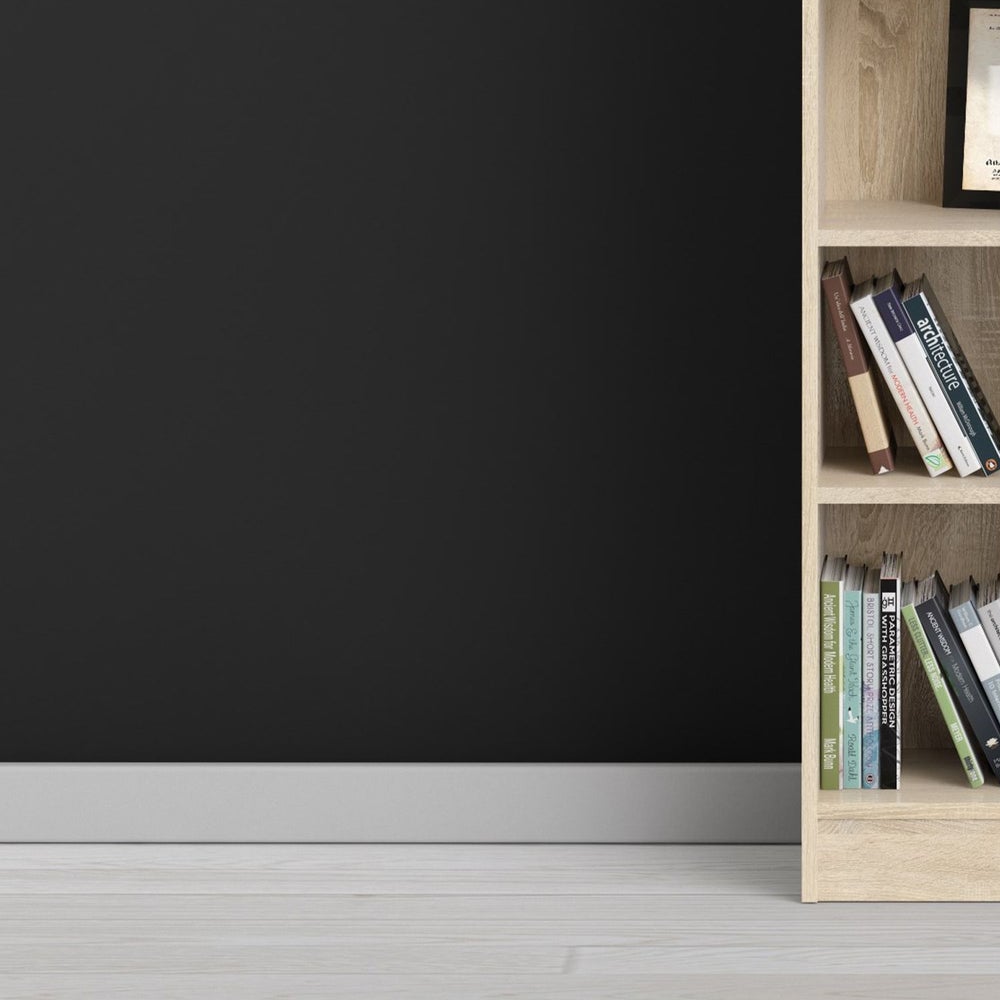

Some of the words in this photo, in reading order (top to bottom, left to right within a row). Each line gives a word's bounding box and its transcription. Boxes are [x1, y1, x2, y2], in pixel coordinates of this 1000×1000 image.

[858, 305, 876, 335] ANCIENT
[872, 335, 890, 365] WISDOM
[890, 373, 907, 402] MODERN
[904, 401, 918, 424] HEALTH
[917, 317, 960, 391] architecture
[823, 593, 836, 616] Ancient
[866, 597, 875, 631] BRISTOL
[823, 616, 836, 640] Wisdom
[925, 610, 941, 633] ANCIENT
[936, 632, 952, 655] WISDOM
[866, 632, 875, 660] SHORT
[823, 651, 836, 674] Modern
[823, 674, 836, 694] Health
[866, 691, 875, 713] PRIZE
[823, 738, 836, 753] Mark
[823, 754, 836, 770] Bunn
